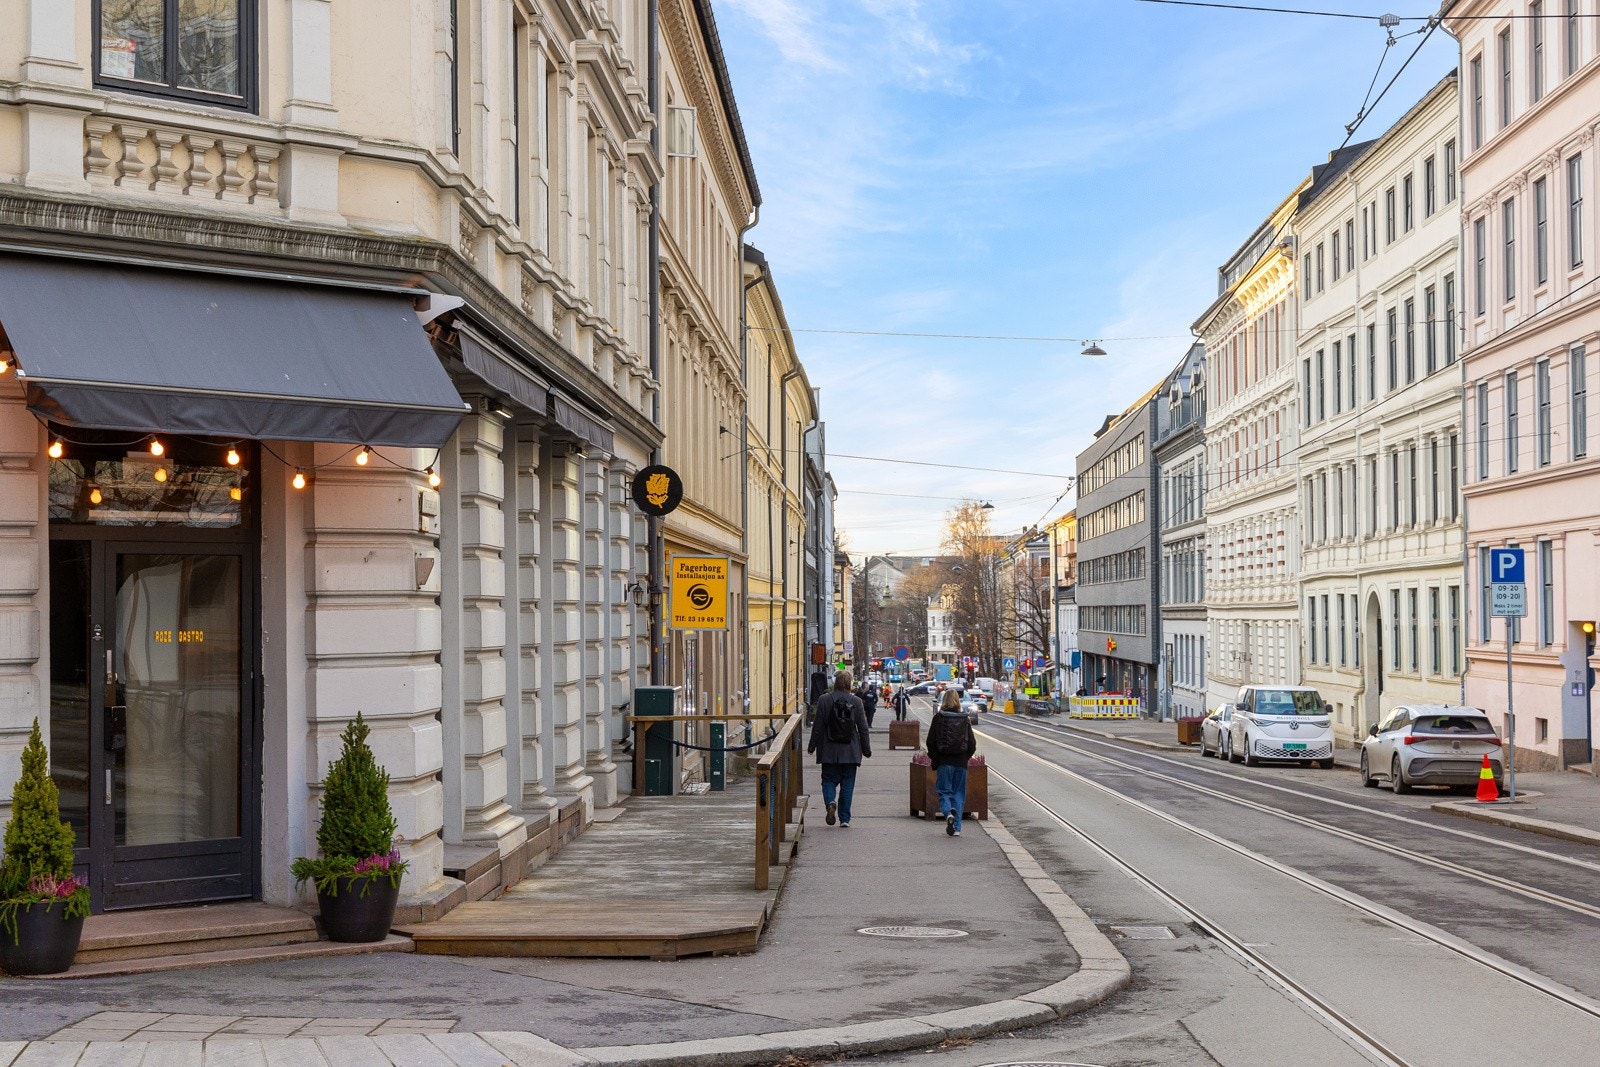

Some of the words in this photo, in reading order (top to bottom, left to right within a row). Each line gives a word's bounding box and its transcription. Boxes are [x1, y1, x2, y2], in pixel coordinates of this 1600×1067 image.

[680, 563, 721, 573] Fagerborg
[1499, 553, 1517, 578] P
[155, 630, 172, 643] ROZE
[178, 630, 204, 643] GASTRO
